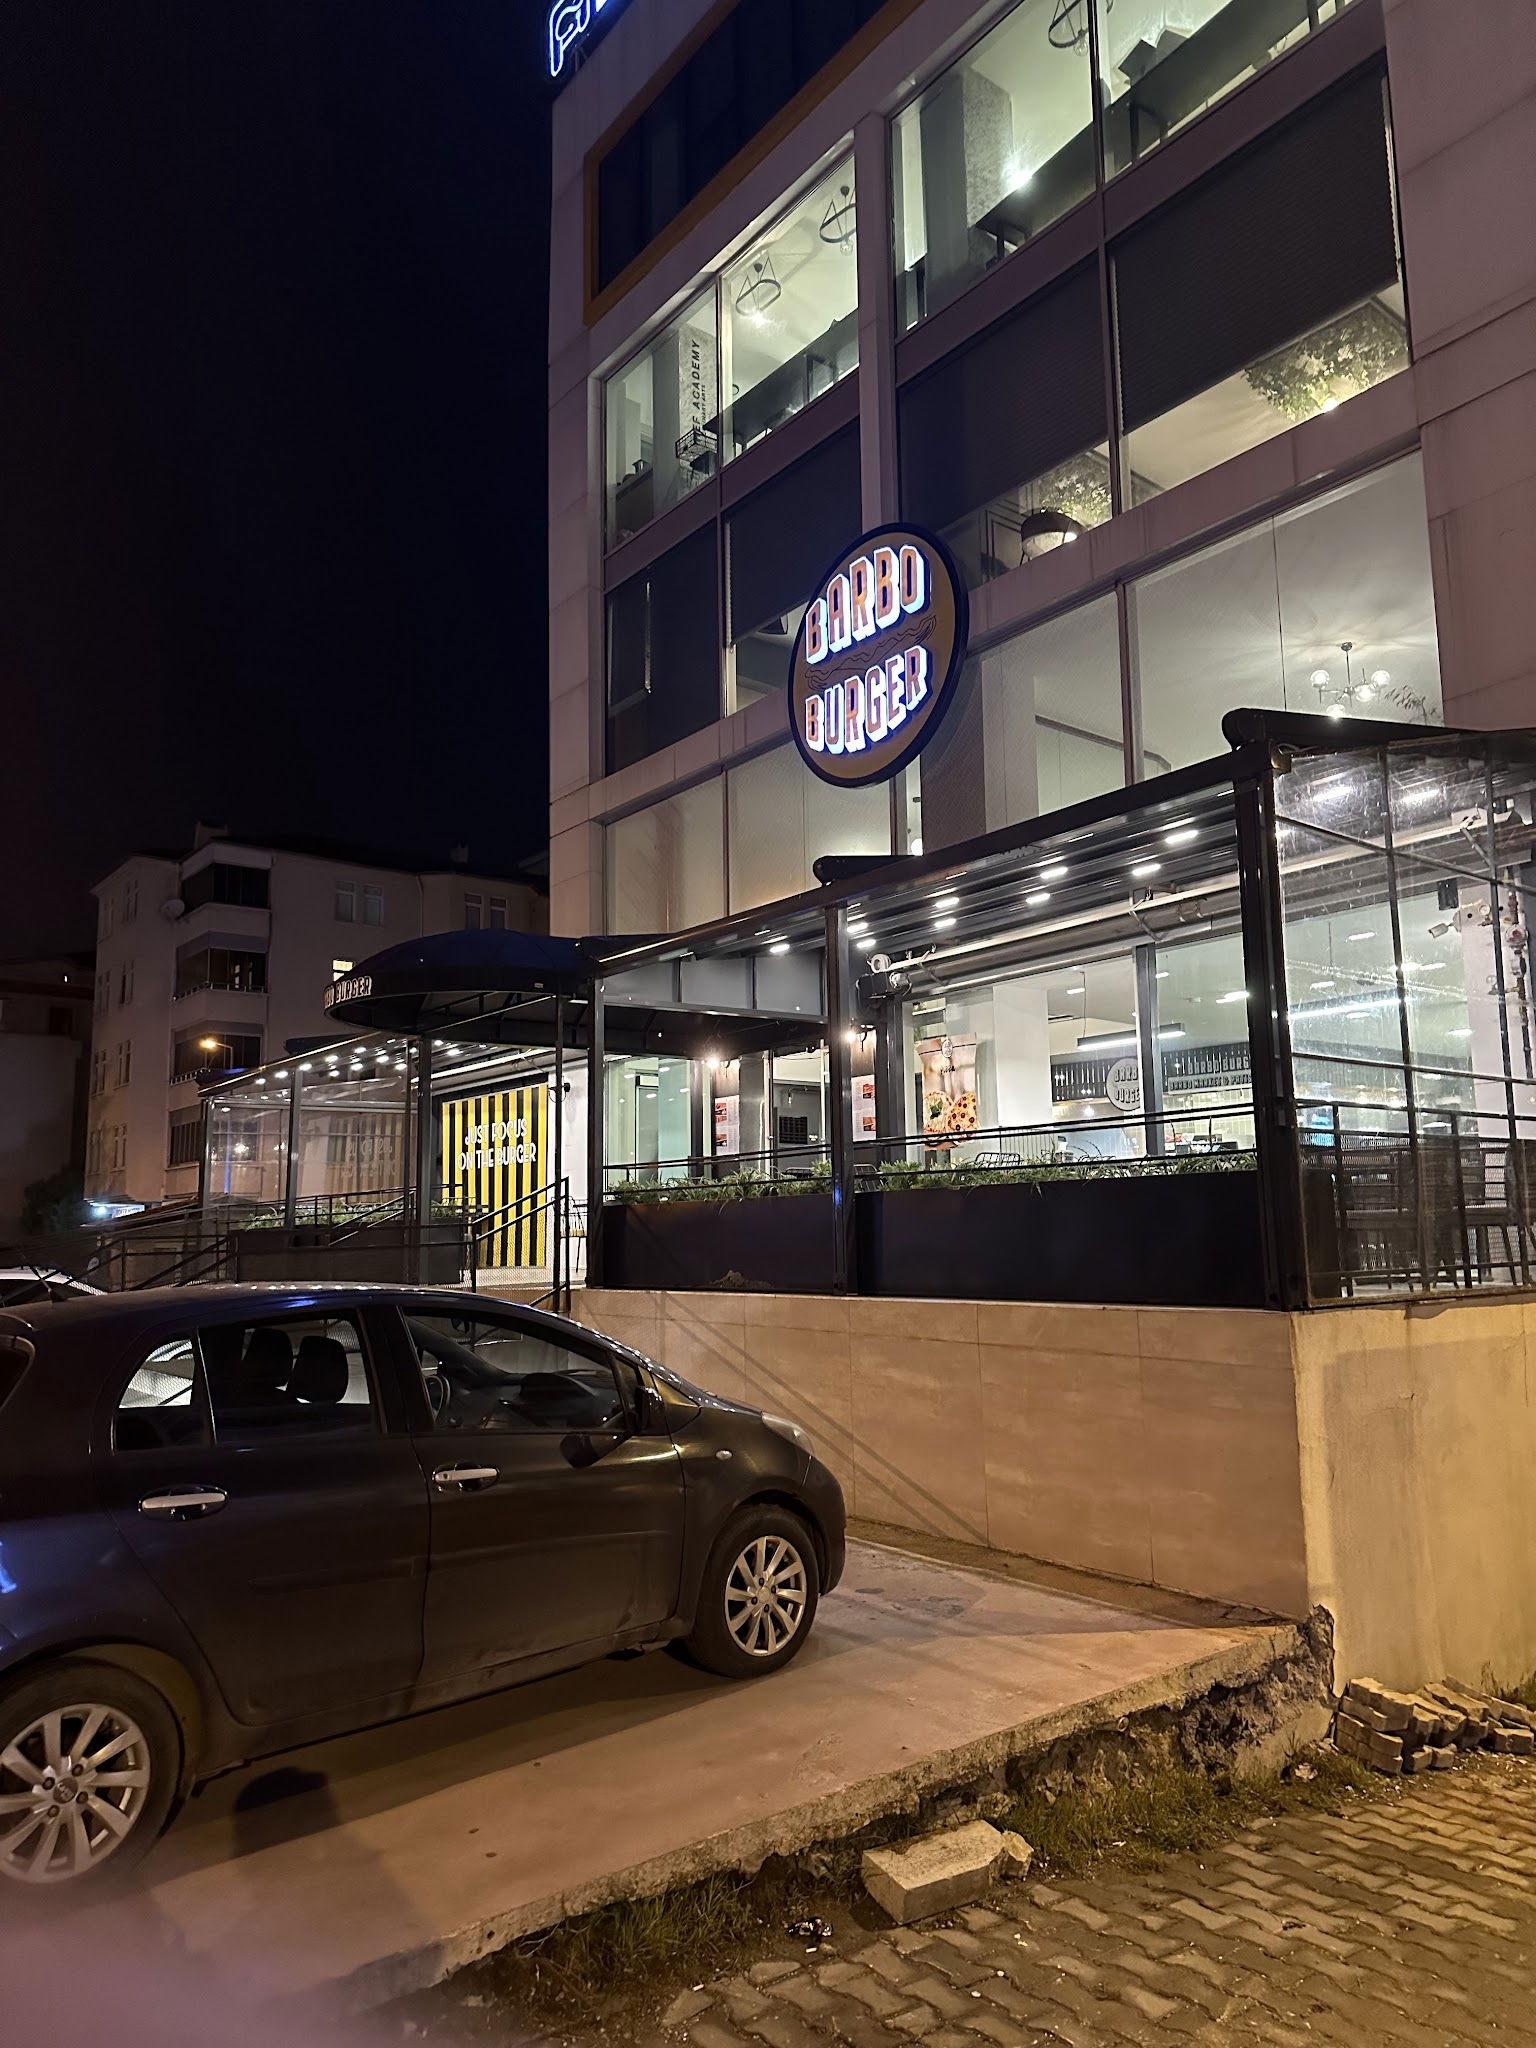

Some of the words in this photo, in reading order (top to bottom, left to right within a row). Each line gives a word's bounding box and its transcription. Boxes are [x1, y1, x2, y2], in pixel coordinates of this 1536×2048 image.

[692, 339, 701, 410] ACADEMY
[805, 544, 925, 665] BARBO
[805, 645, 928, 755] BURGER
[335, 975, 373, 1004] BURGER
[1114, 1063, 1138, 1083] BARB
[1188, 1060, 1219, 1075] BARBO
[1222, 1056, 1250, 1071] BURG
[1114, 1087, 1140, 1104] BURGE
[464, 1123, 490, 1146] JUST
[491, 1118, 528, 1143] FOCUS
[458, 1151, 474, 1171] ON
[475, 1147, 494, 1169] THE
[496, 1142, 537, 1166] BURGER
